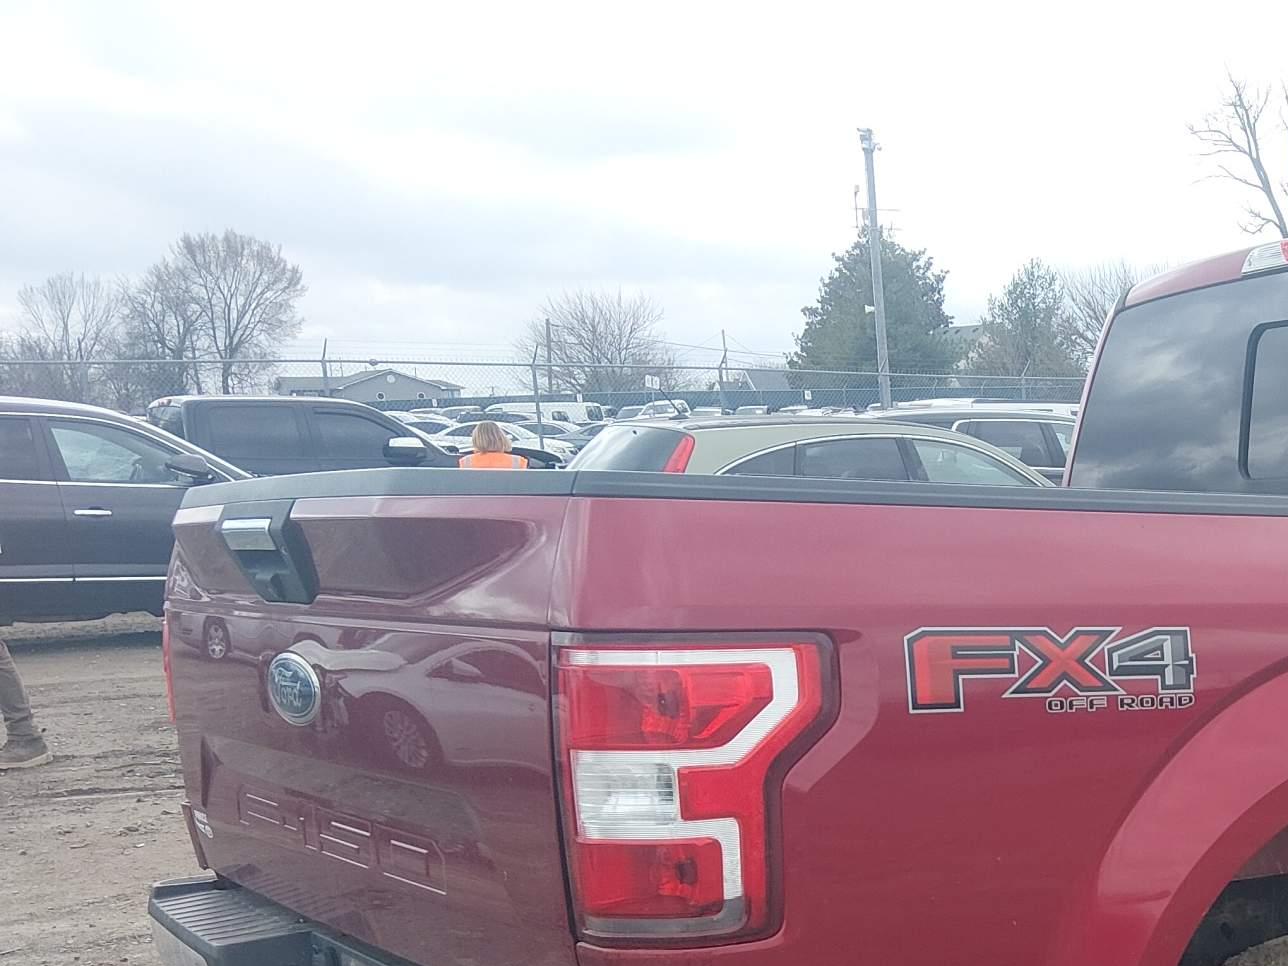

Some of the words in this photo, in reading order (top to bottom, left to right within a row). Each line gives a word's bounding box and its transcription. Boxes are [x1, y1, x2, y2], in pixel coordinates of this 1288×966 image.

[271, 667, 304, 707] Ford
[904, 626, 1197, 714] FX4
[1046, 696, 1107, 713] OFF
[1118, 694, 1195, 711] ROAD
